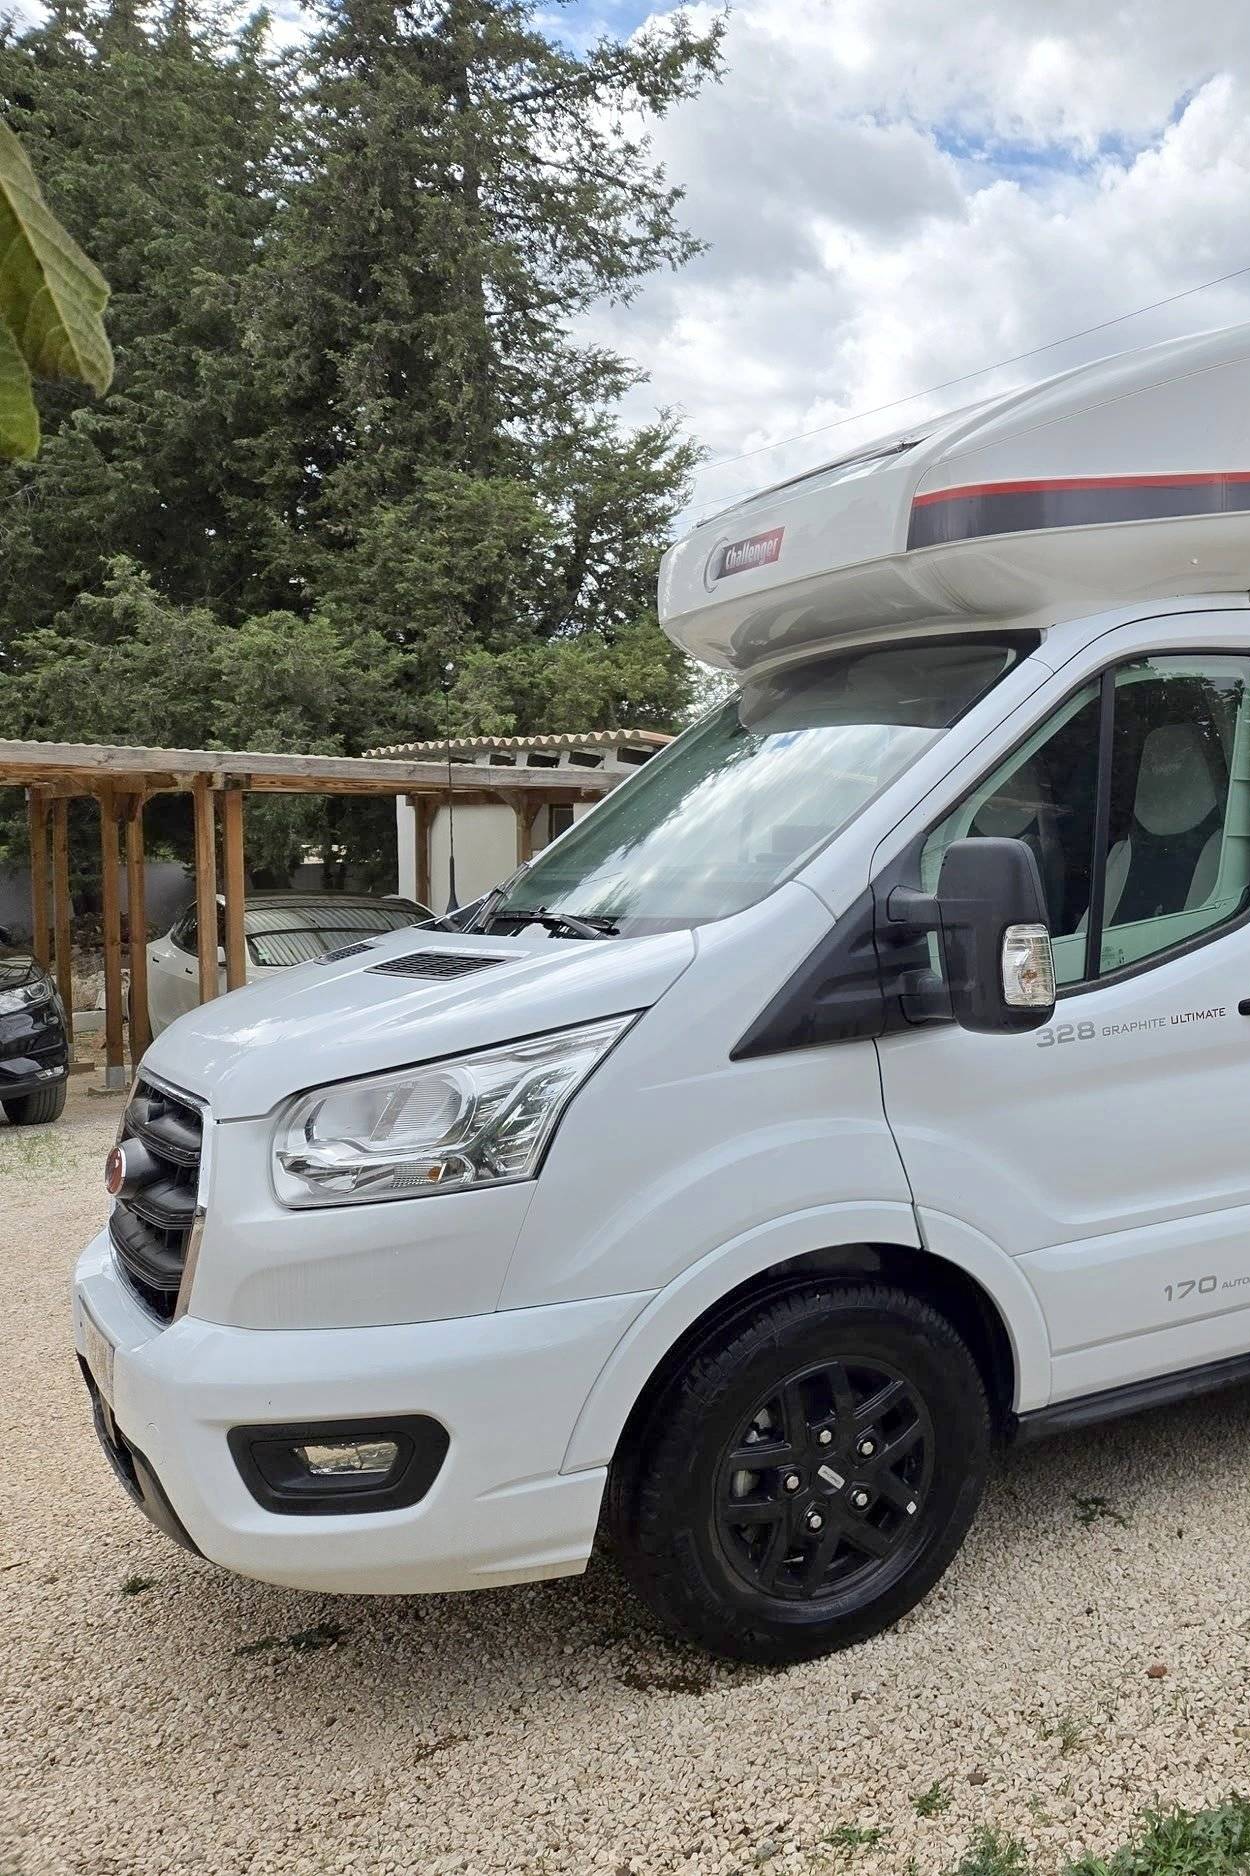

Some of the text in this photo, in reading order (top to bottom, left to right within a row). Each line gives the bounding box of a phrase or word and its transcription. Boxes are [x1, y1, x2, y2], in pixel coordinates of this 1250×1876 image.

[725, 537, 779, 570] Challenger
[1035, 1007, 1227, 1048] 328 GRAPHITE ULTIMATE
[1164, 1275, 1217, 1301] 170
